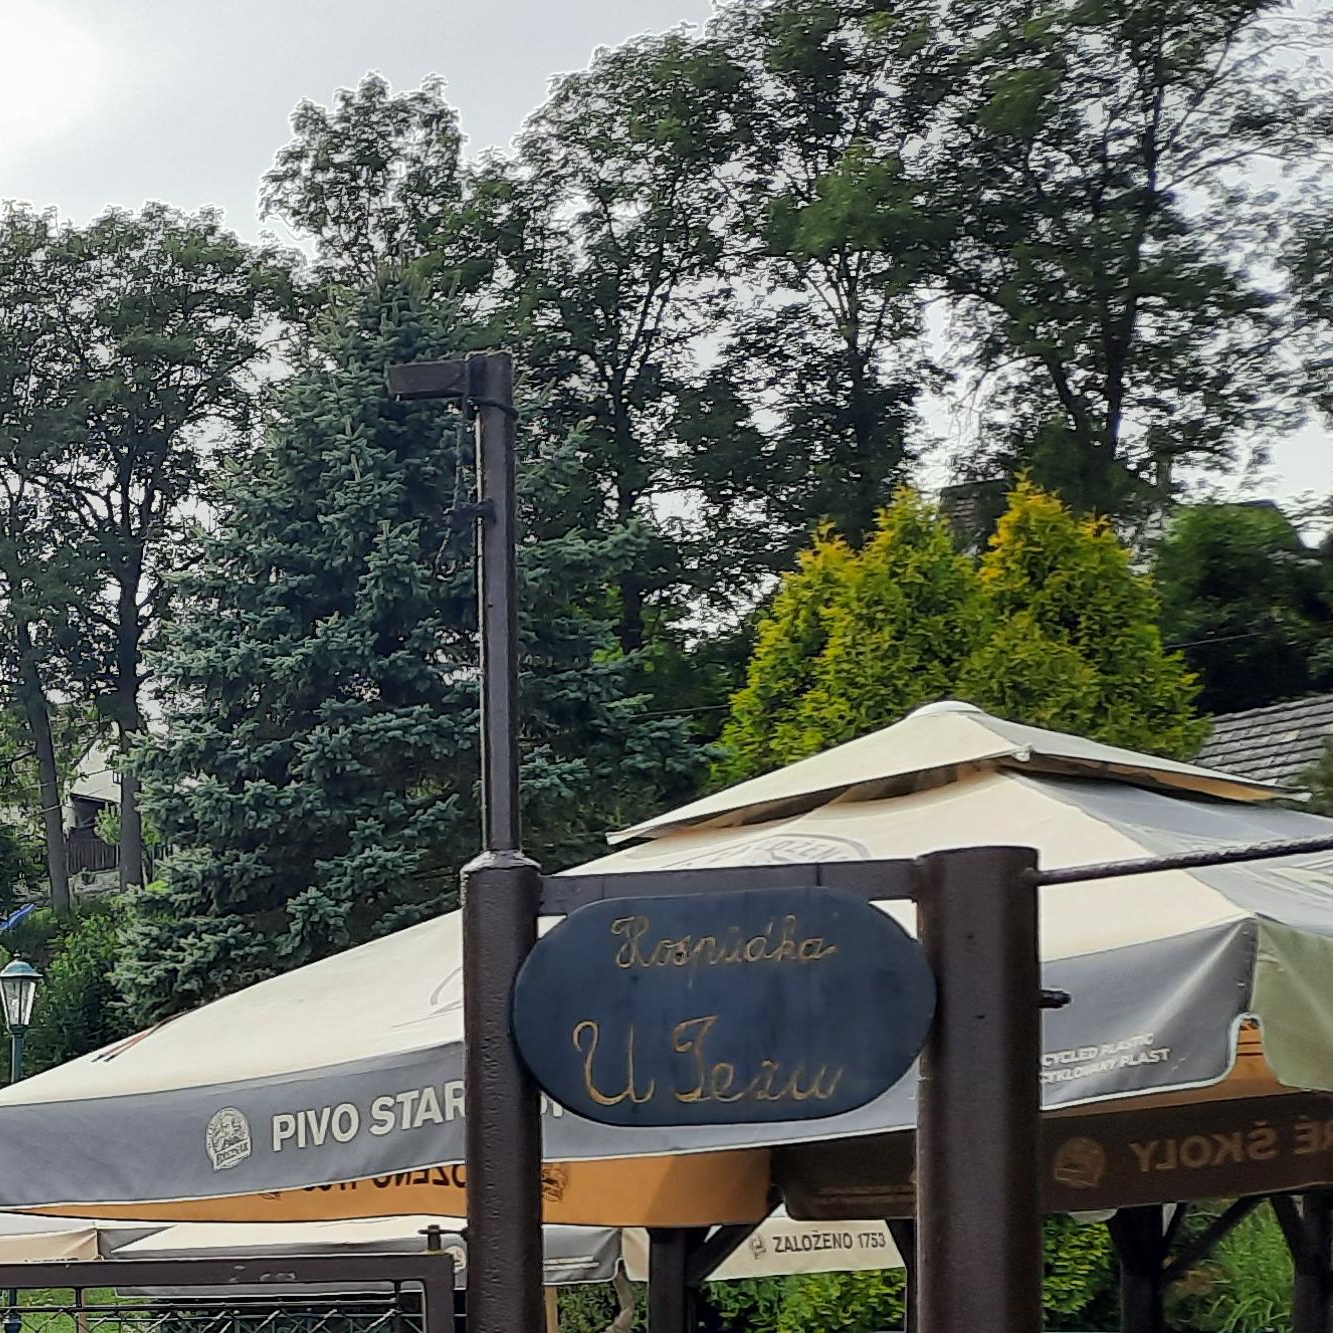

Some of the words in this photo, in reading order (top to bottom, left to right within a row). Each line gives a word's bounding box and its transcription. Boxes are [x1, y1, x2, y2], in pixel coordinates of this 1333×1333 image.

[572, 1019, 657, 1106] U
[271, 1102, 360, 1152] PIVO
[369, 1080, 467, 1137] STAR
[772, 1229, 853, 1253] ZALOŽENO
[857, 1232, 886, 1250] 1753
